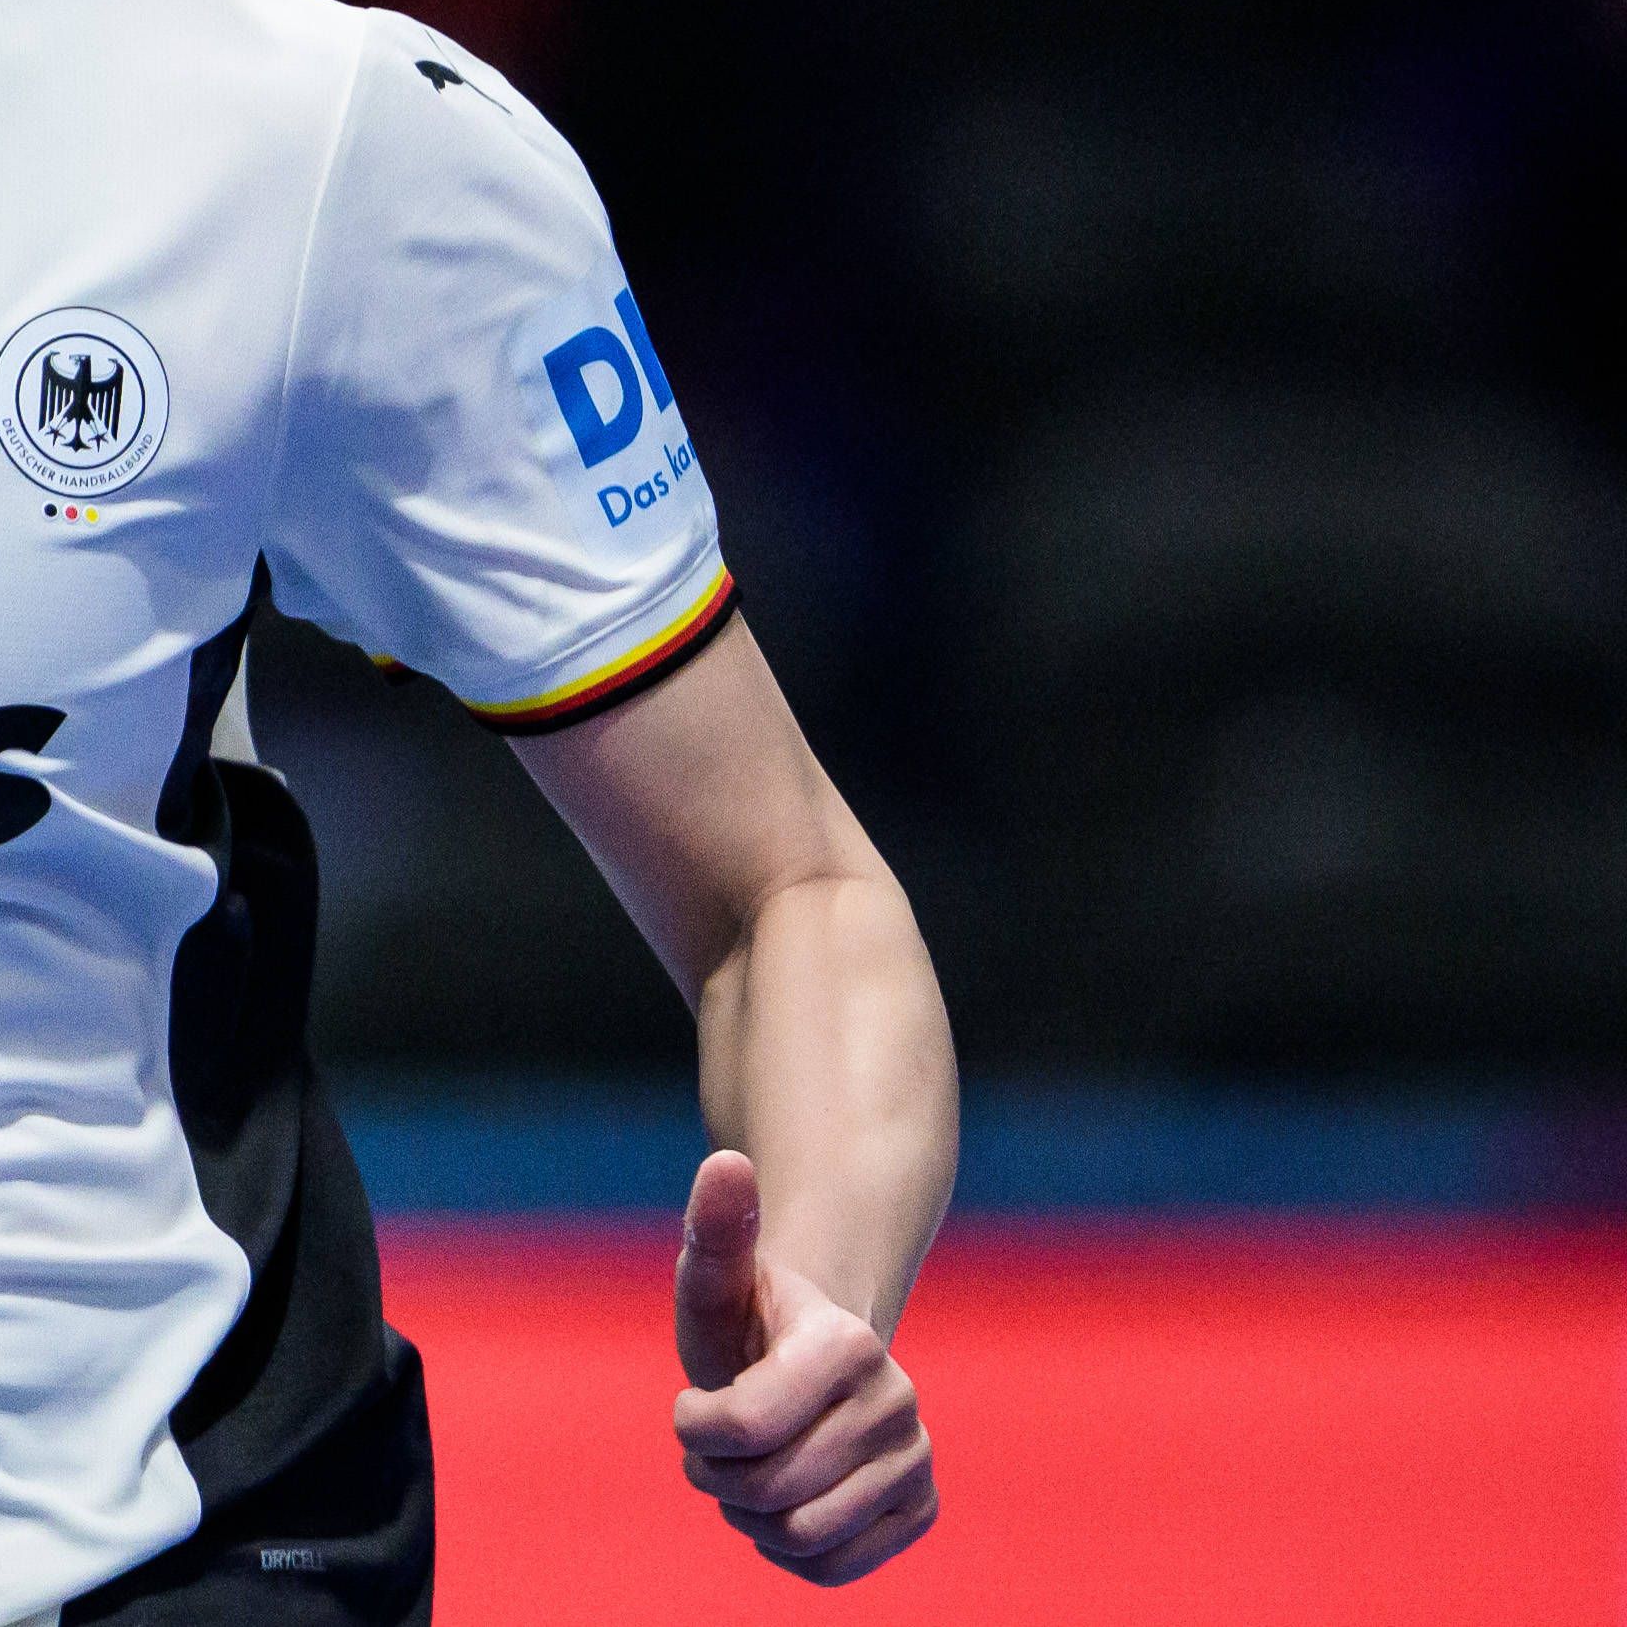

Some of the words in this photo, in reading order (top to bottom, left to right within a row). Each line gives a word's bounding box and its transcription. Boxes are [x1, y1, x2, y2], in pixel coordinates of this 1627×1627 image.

[2, 417, 56, 482] DEUTSCHER
[59, 433, 153, 489] HANDBALLBUND
[597, 471, 669, 529] Das
